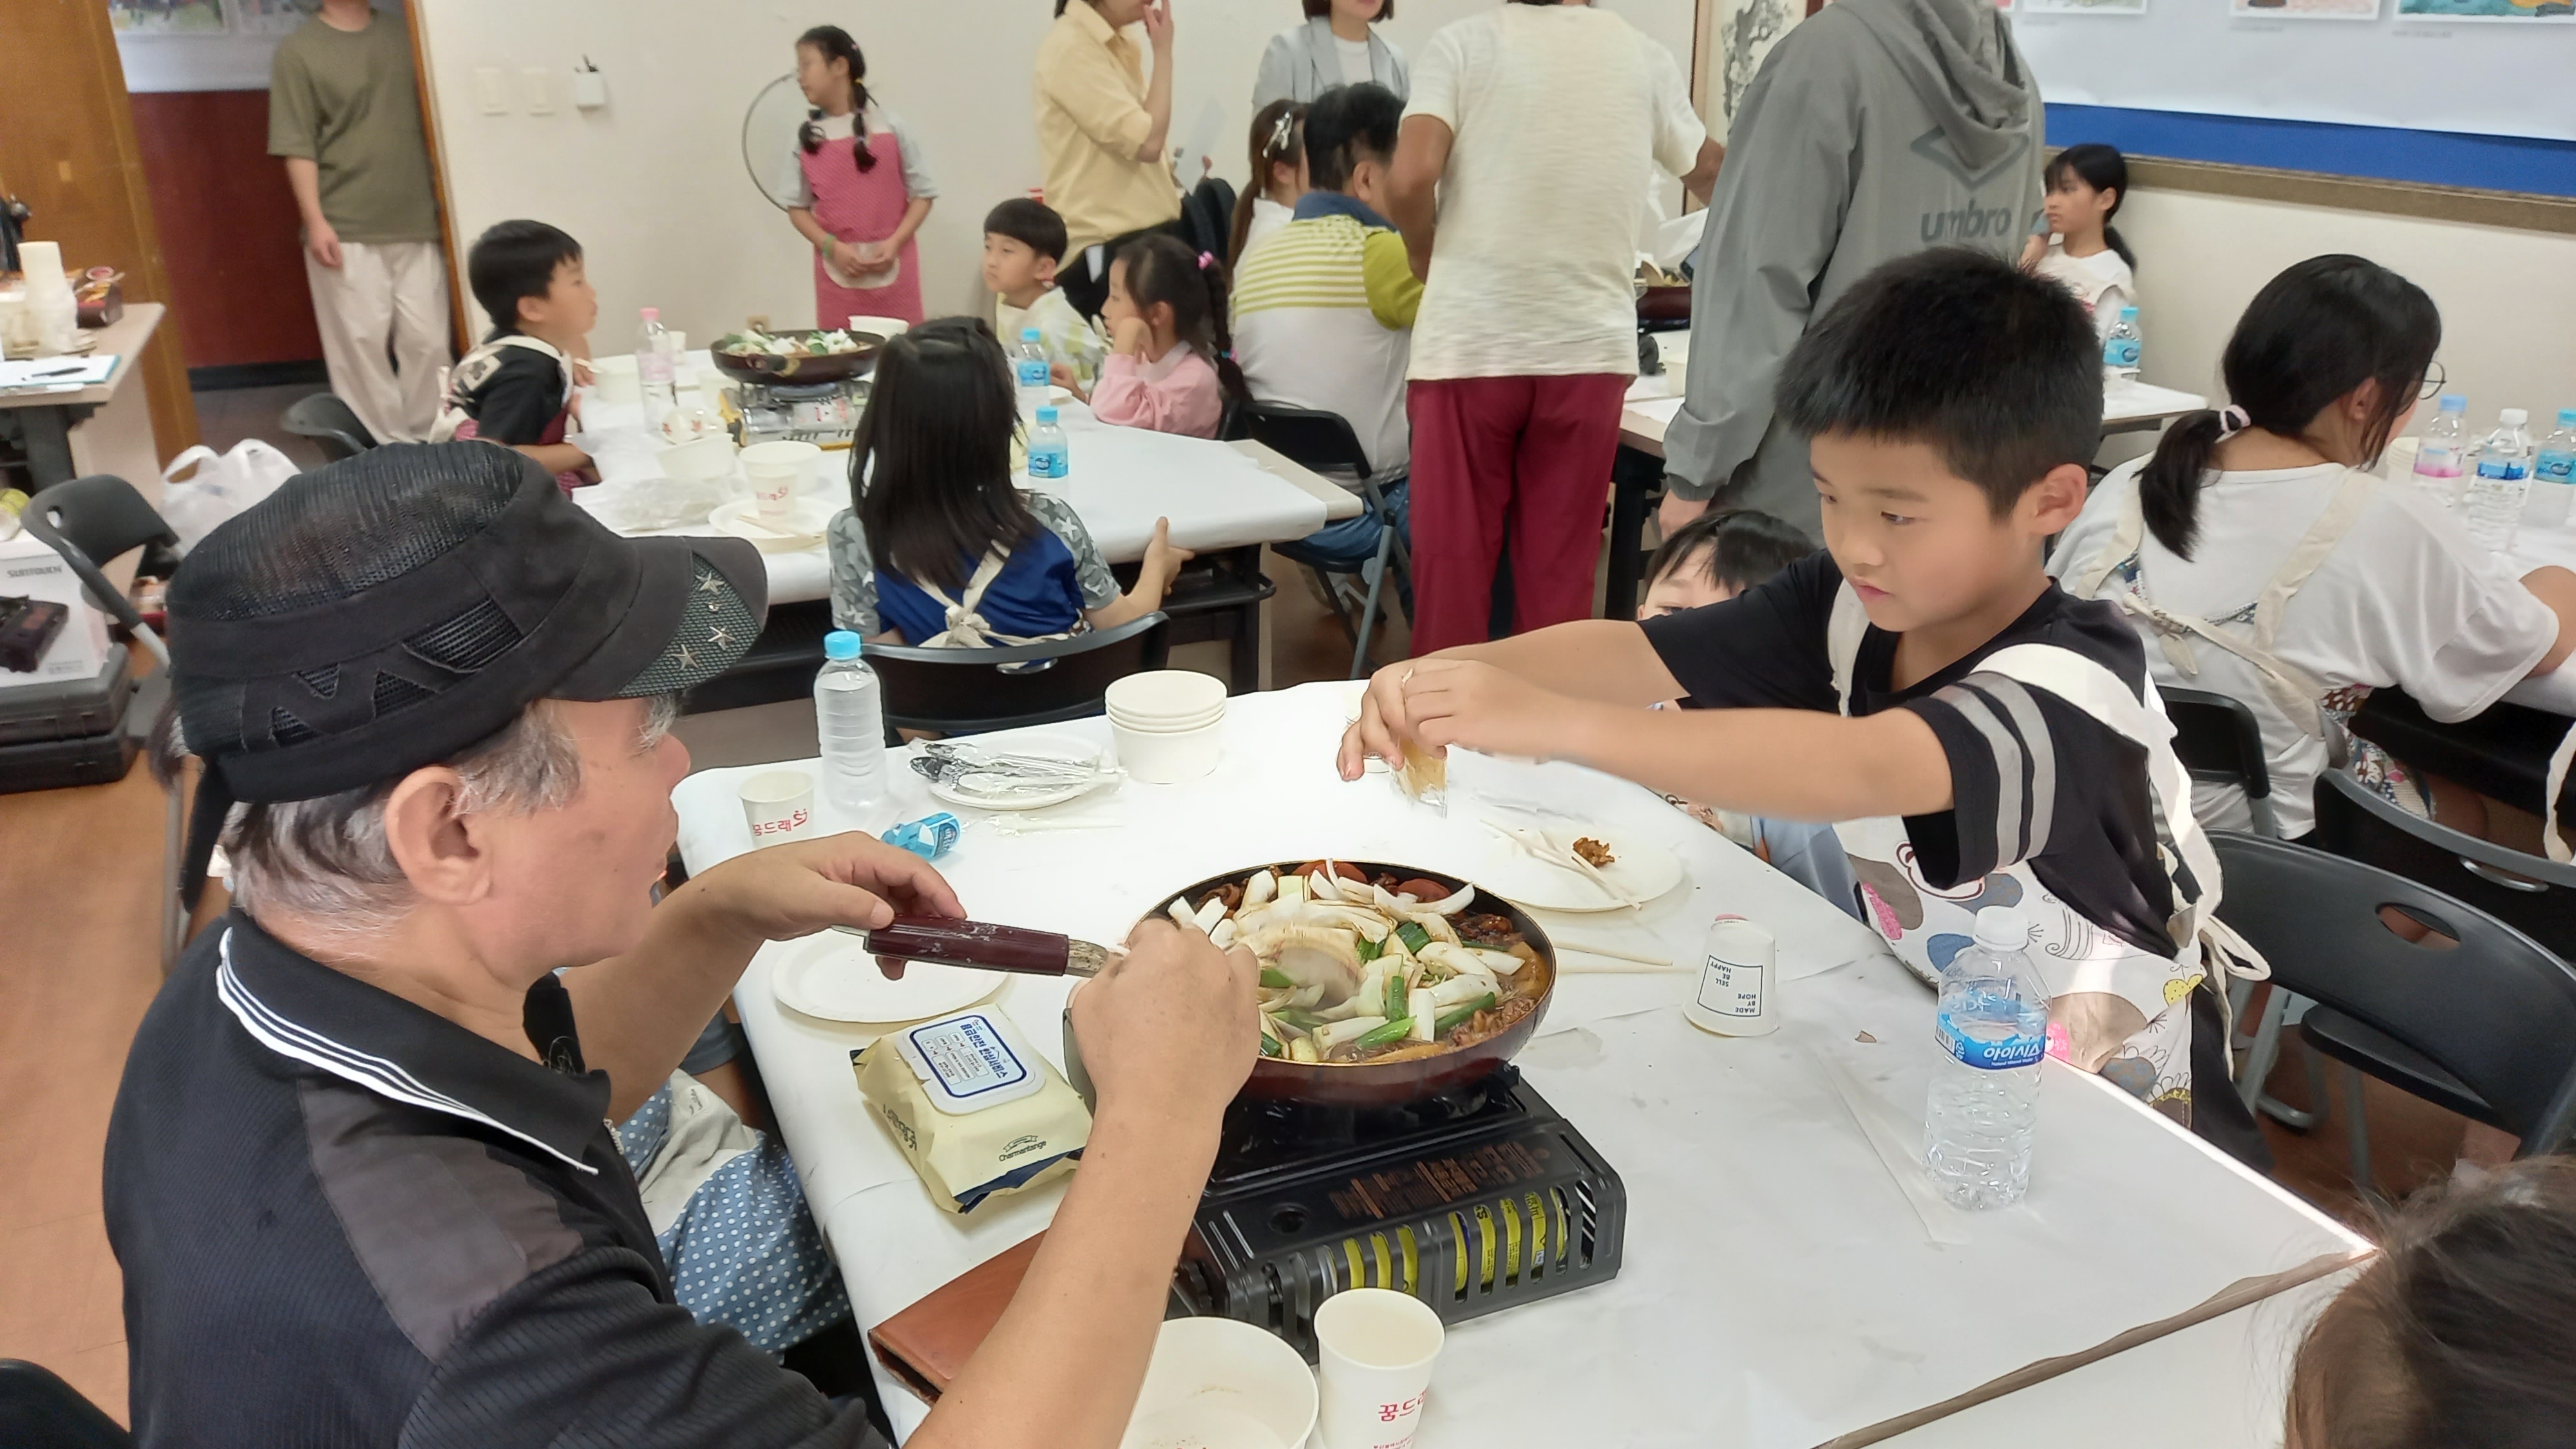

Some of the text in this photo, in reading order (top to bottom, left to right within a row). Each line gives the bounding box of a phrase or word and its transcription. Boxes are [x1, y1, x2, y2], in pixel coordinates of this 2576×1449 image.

[1921, 200, 2012, 242] umbro
[1710, 961, 1731, 973] HAPPY
[1715, 978, 1729, 987] SELL
[1983, 1043, 2041, 1061] 아이시스
